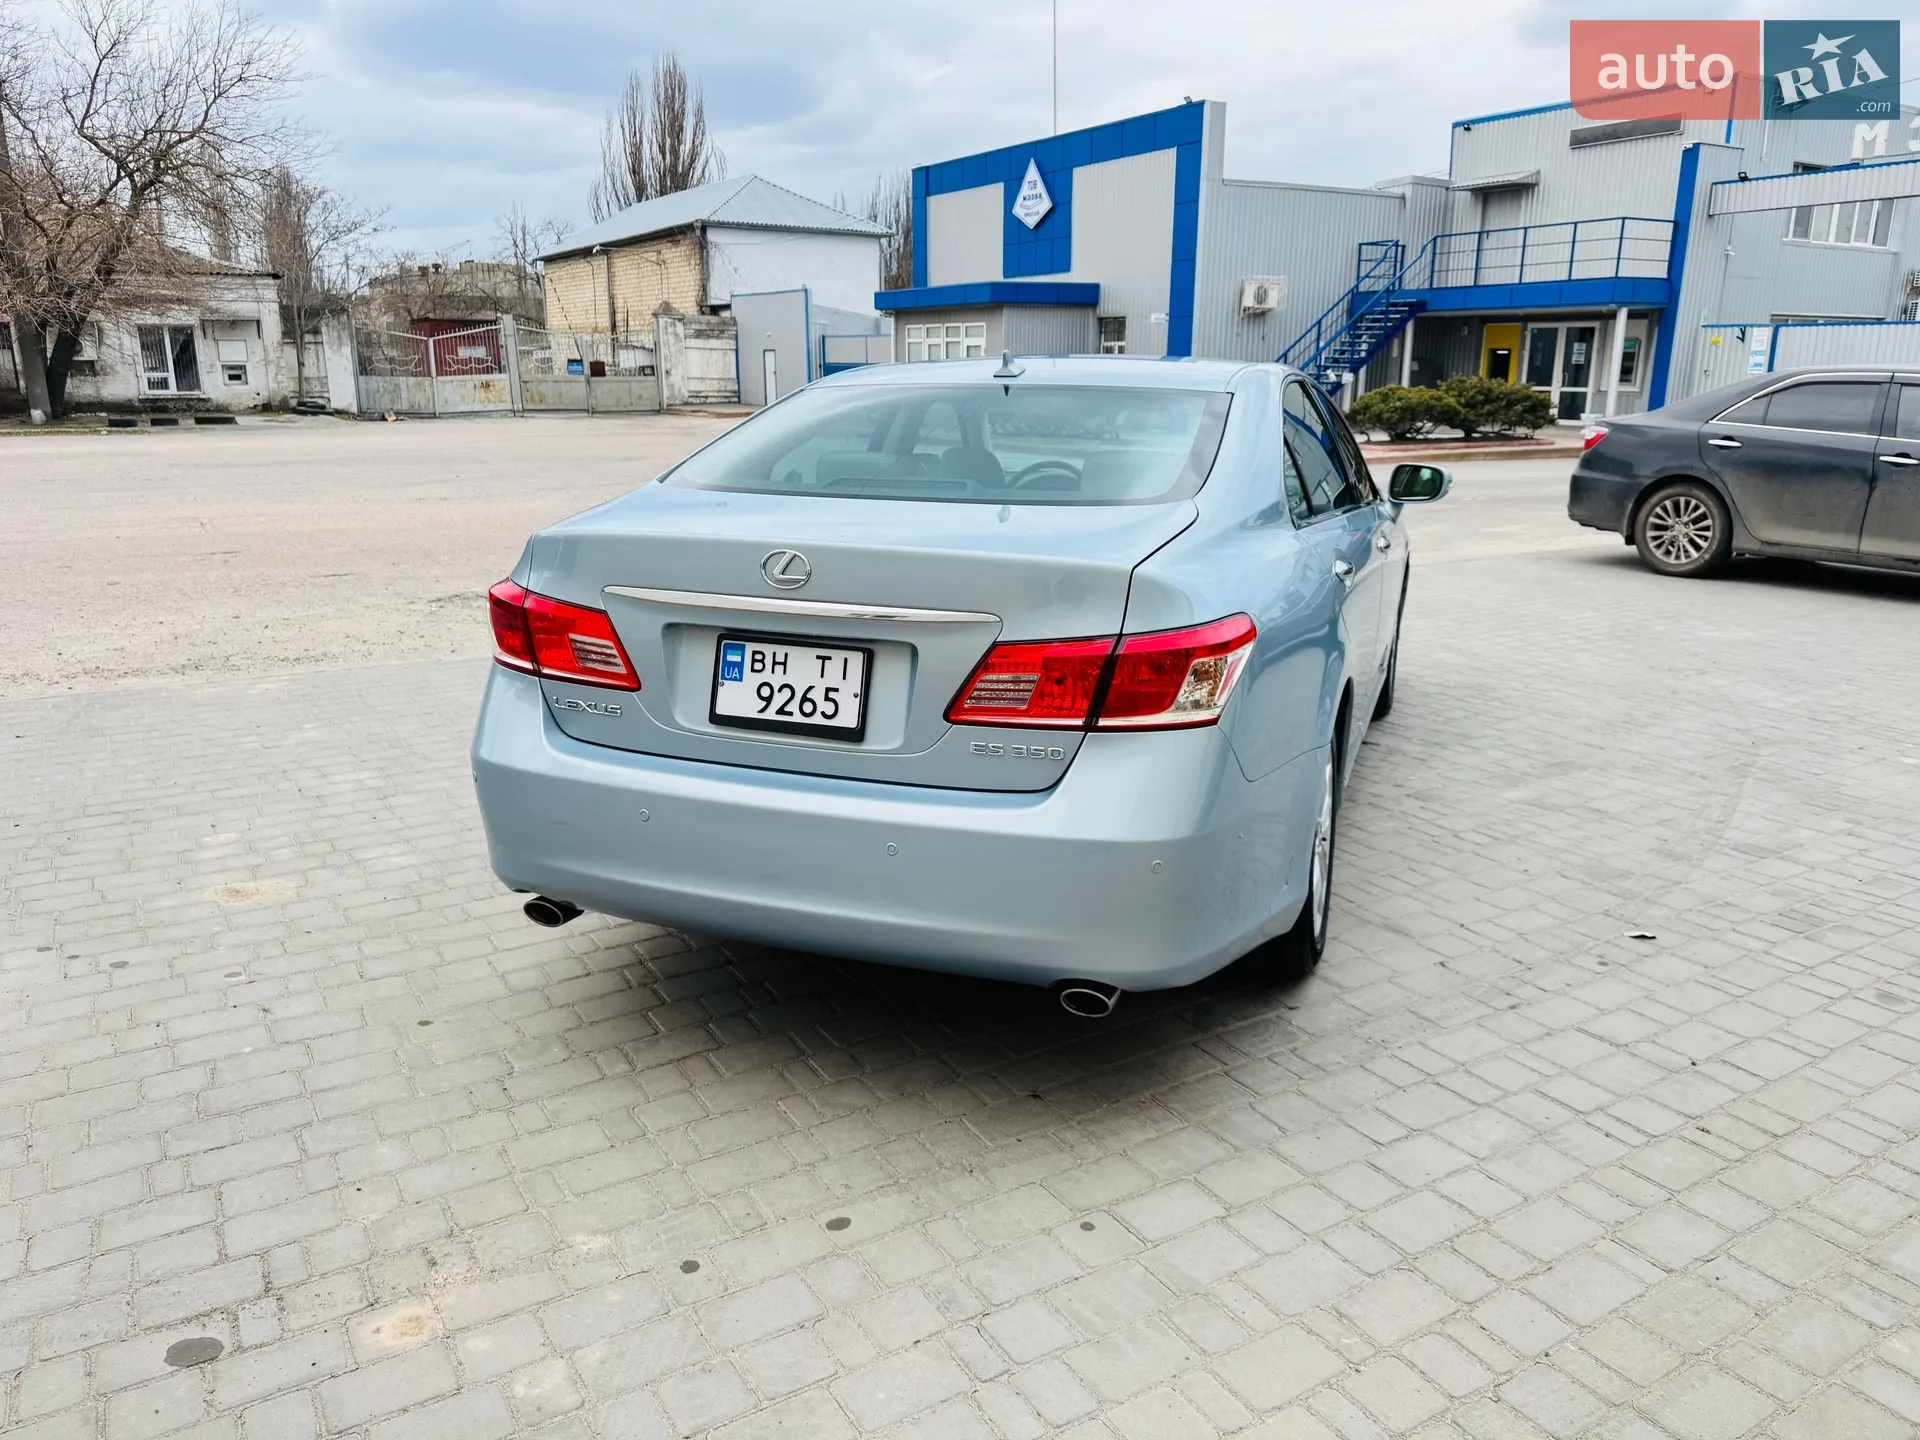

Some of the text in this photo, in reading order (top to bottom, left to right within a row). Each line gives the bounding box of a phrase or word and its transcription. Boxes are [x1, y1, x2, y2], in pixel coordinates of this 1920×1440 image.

[724, 666, 740, 679] UA
[750, 650, 788, 675] BH
[552, 696, 623, 717] LEXUS
[756, 681, 840, 720] 9265
[969, 741, 1065, 760] ES 350
